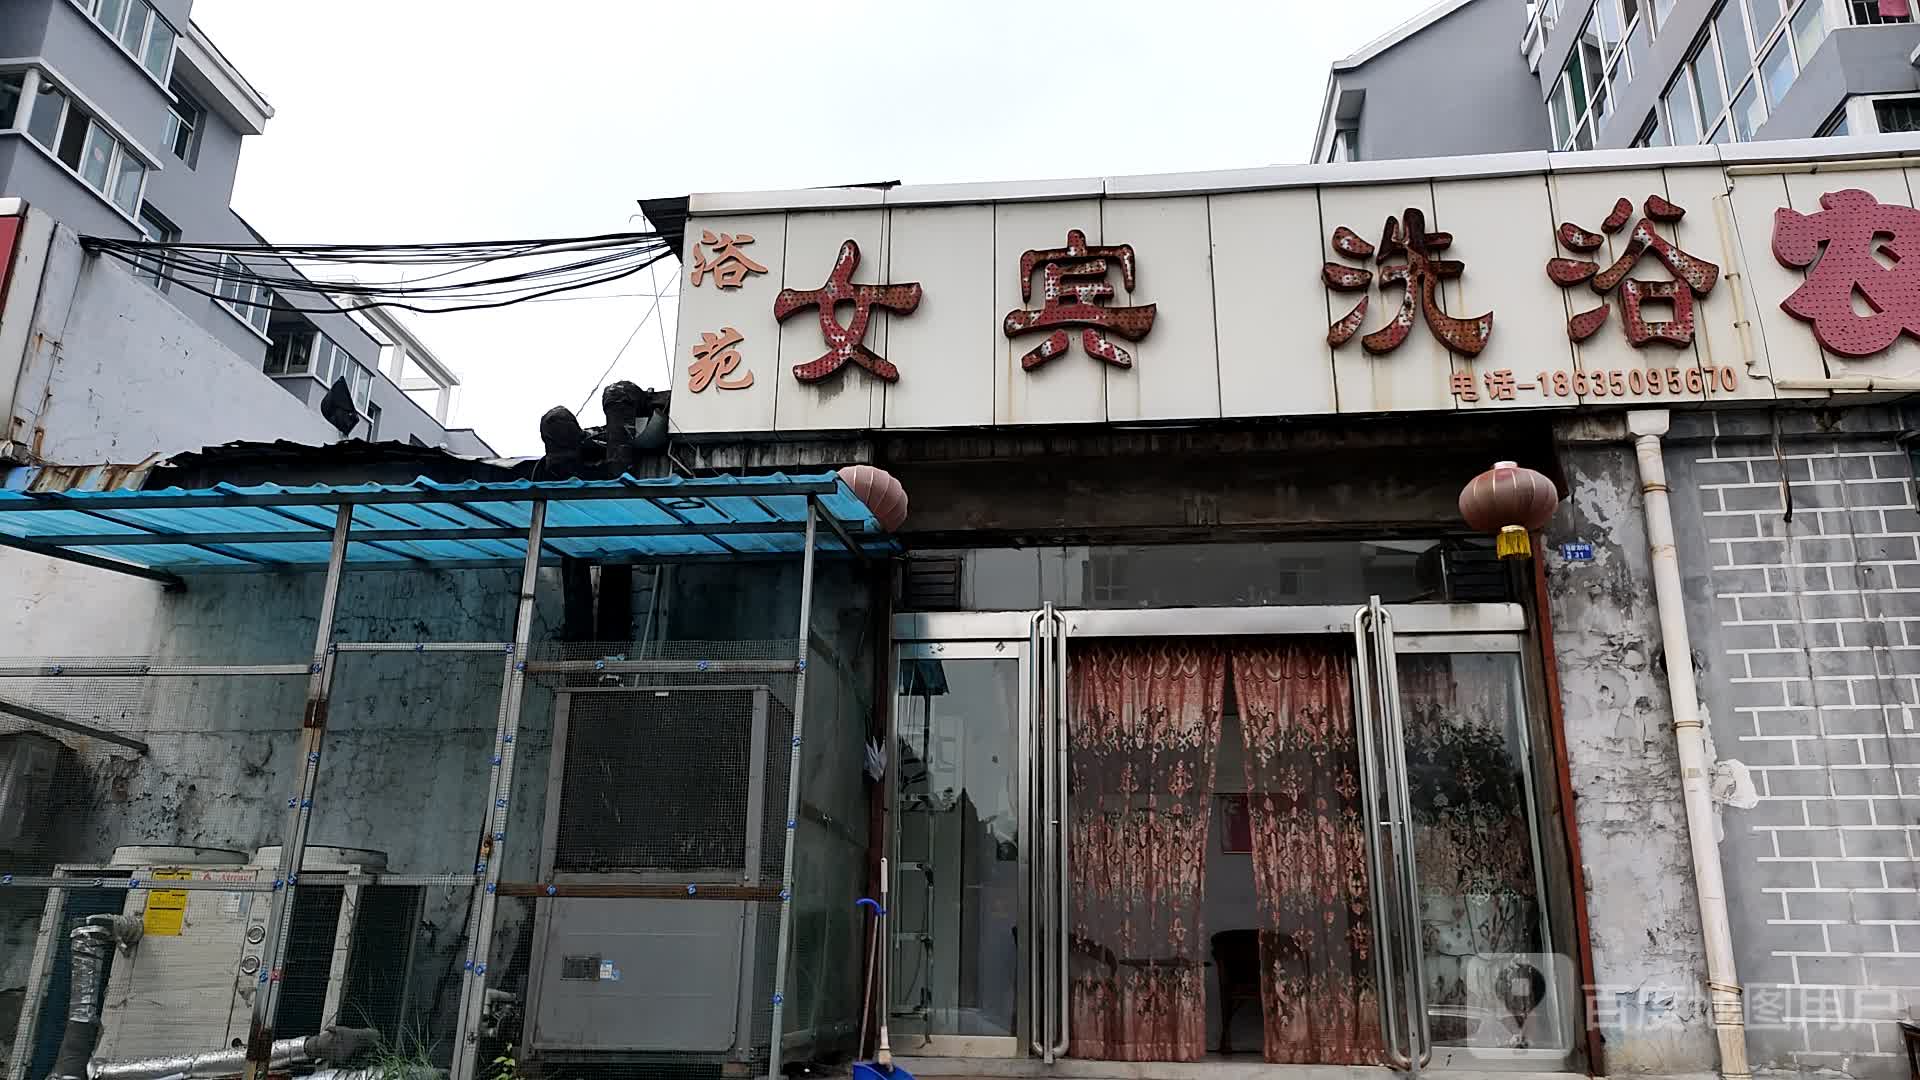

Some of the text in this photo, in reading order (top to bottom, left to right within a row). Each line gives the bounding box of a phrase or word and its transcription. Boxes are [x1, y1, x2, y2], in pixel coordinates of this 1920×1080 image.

[689, 229, 769, 393] 浴苑
[774, 194, 1719, 384] 女宾洗浴
[1450, 366, 1738, 401] 电话-18635095670
